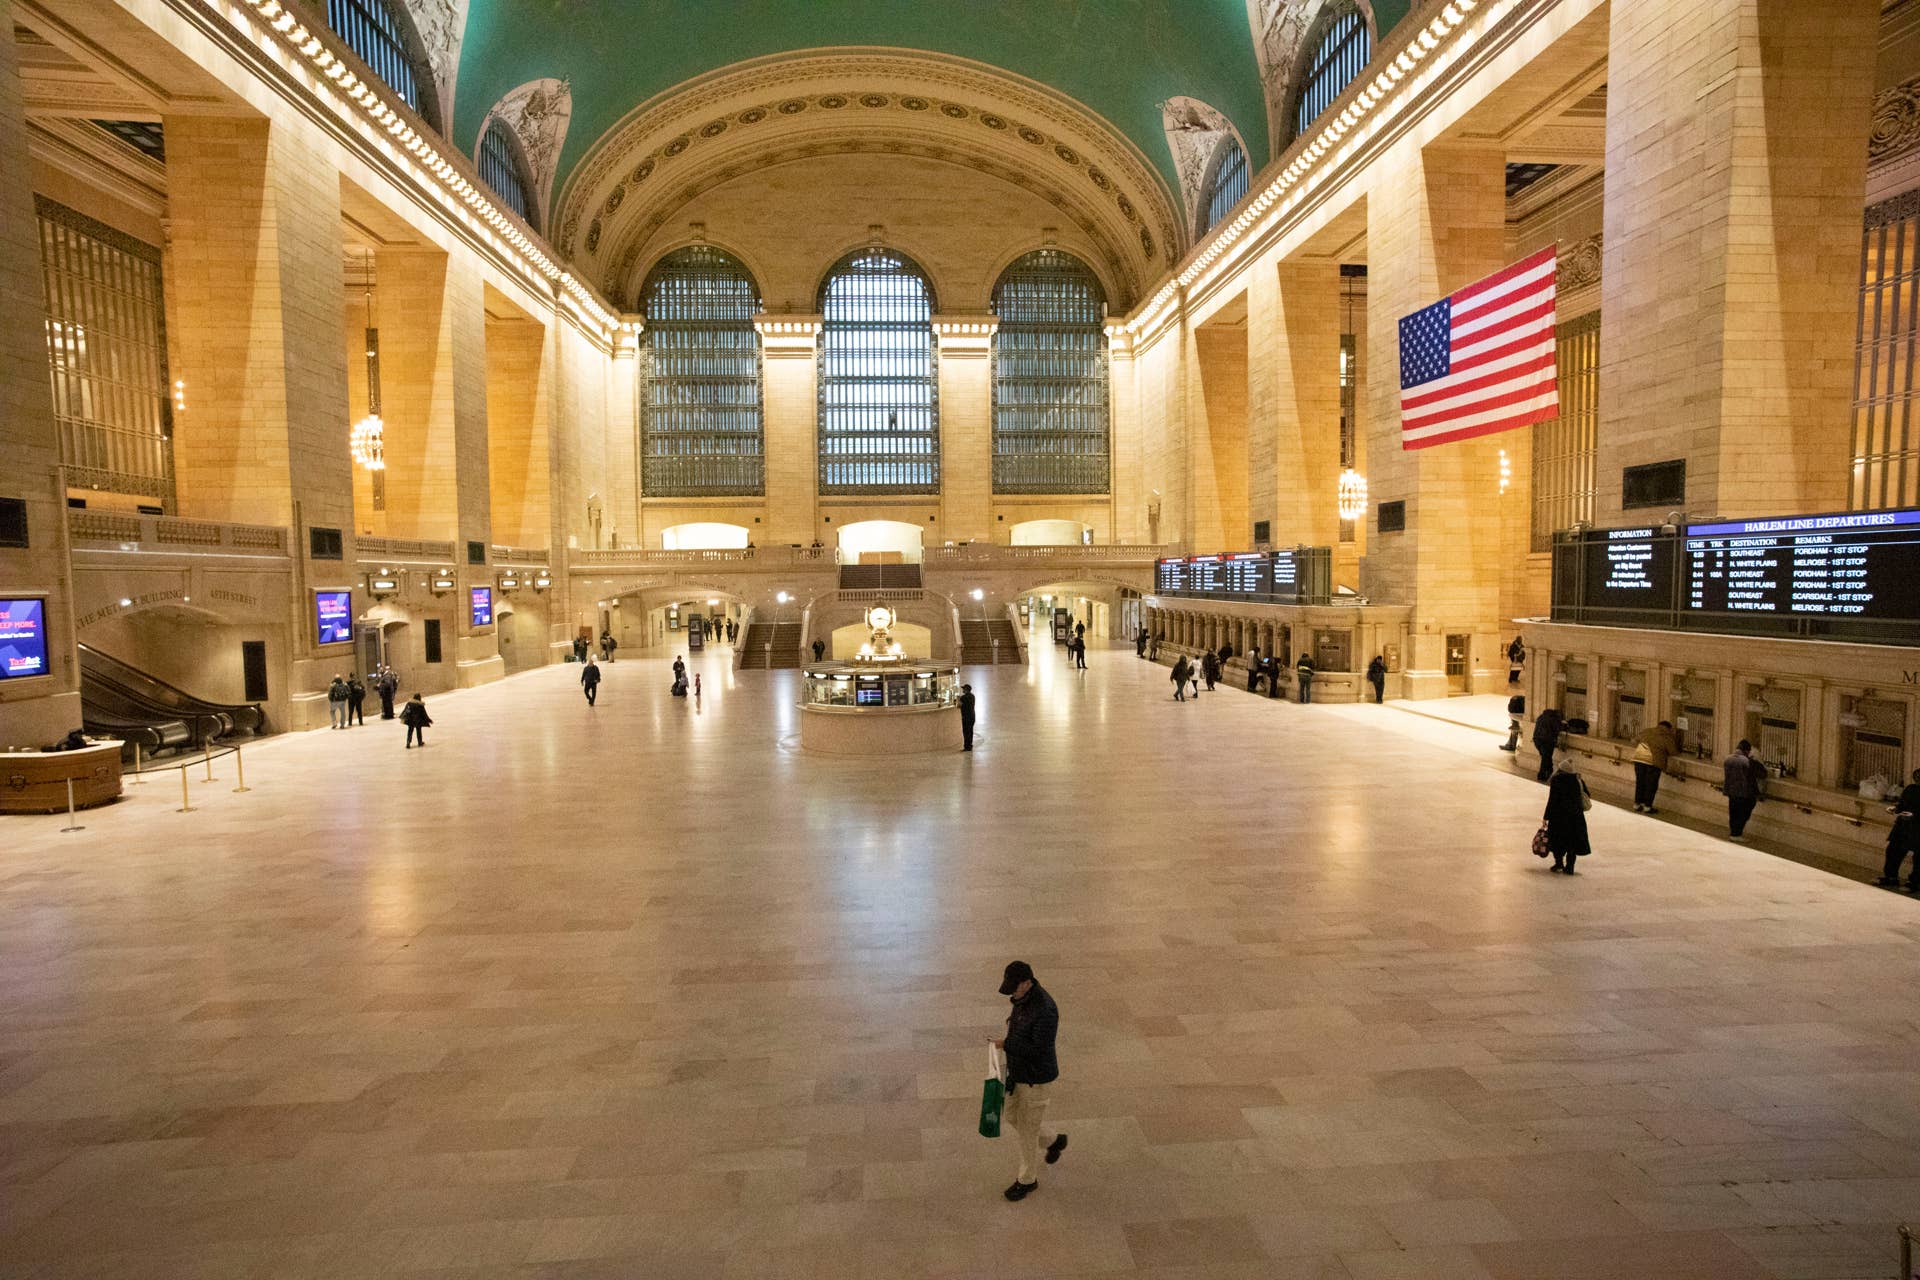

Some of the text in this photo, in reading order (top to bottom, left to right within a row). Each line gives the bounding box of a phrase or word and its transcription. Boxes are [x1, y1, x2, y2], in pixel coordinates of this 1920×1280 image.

[1744, 513, 1895, 532] HARLEM LINE DEPARTURES
[1608, 529, 1652, 539] INFORMATION
[1729, 538, 1777, 547] DESTINATION
[1795, 536, 1832, 544] REMARKS
[1729, 549, 1765, 557] SOUTHEAST
[1794, 547, 1828, 555] FORDHAM
[1833, 546, 1847, 554] 1ST
[1847, 546, 1869, 554] STOP
[1729, 570, 1764, 578] SOUTHEAST
[140, 589, 183, 606] BUILDING
[230, 591, 257, 606] STREET
[1728, 591, 1764, 599] SOUTHEAST
[1792, 592, 1833, 600] SCARSDALE
[1851, 593, 1873, 601] STOP
[1753, 602, 1775, 610] PLAINS
[1791, 603, 1824, 611] MELROSE
[1843, 605, 1864, 613] STOP
